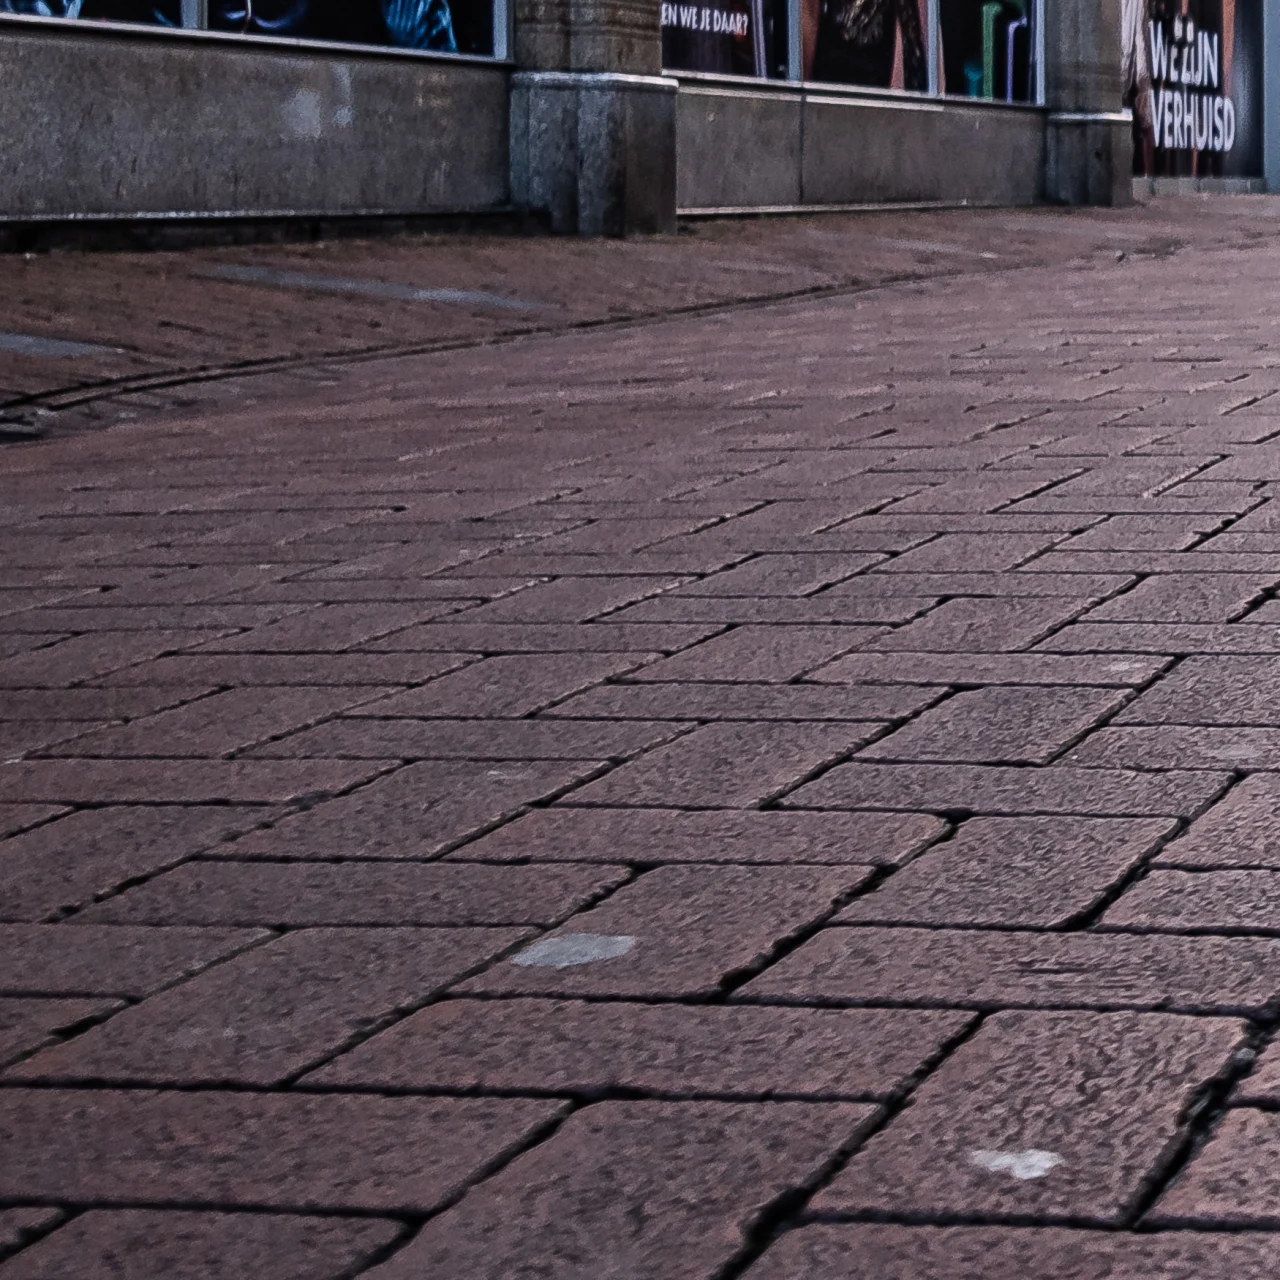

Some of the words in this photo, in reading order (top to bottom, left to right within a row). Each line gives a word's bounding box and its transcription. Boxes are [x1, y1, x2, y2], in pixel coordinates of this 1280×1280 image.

[680, 5, 698, 30] WE
[700, 7, 711, 31] JE
[713, 9, 748, 36] DAAR?
[1149, 20, 1178, 83] WE
[1149, 89, 1235, 151] VERHUISD
